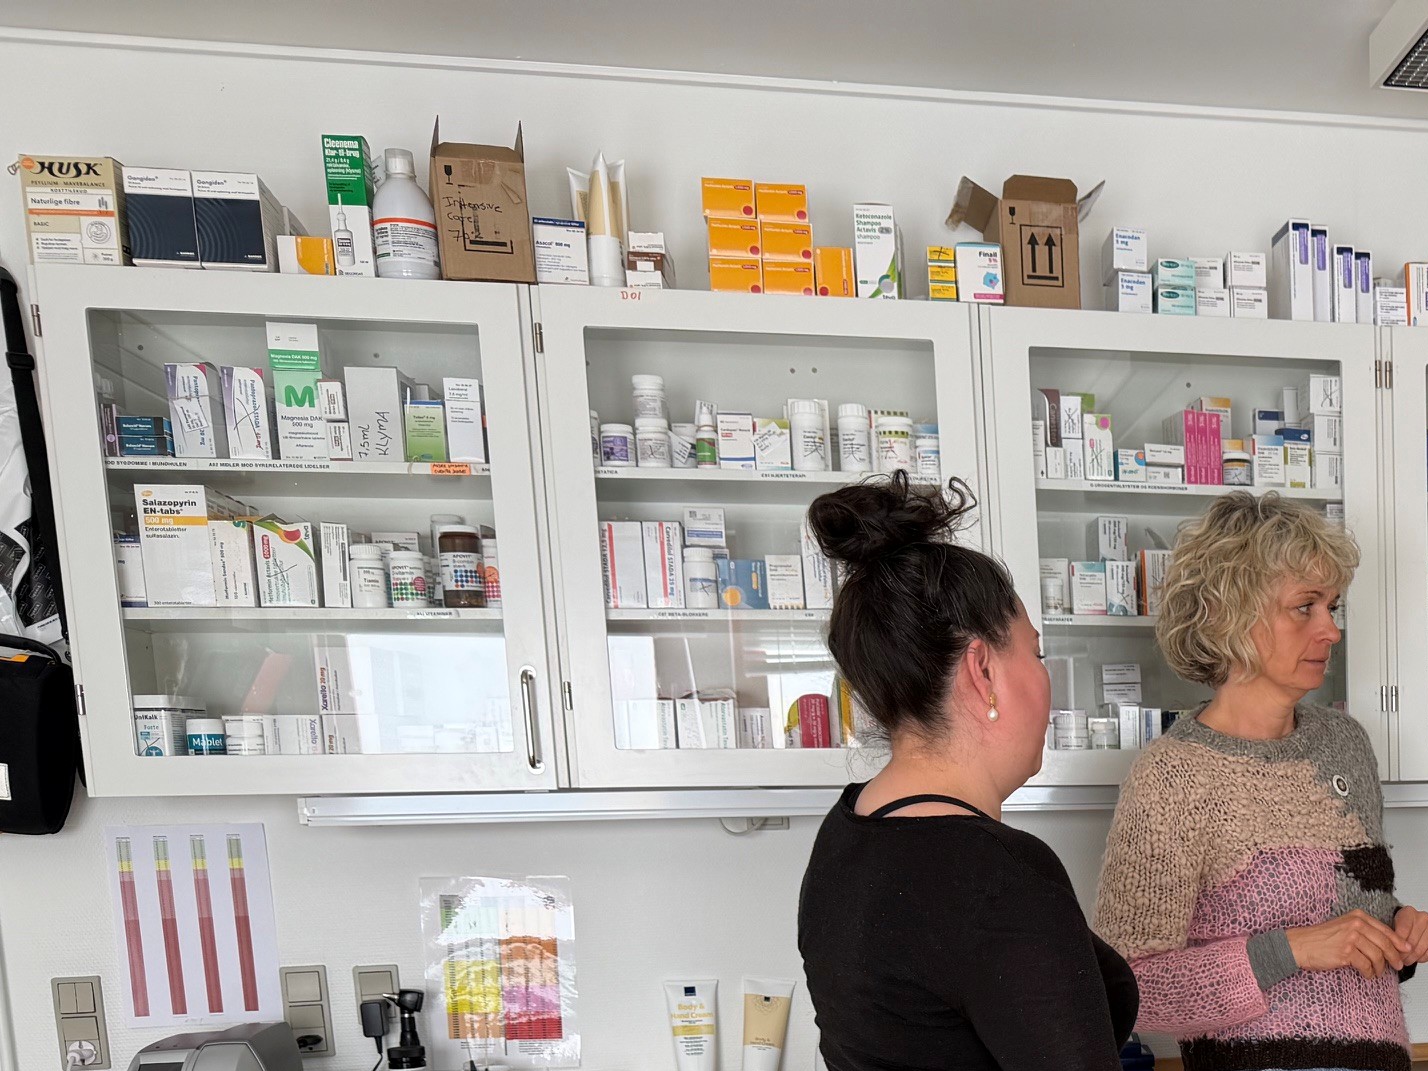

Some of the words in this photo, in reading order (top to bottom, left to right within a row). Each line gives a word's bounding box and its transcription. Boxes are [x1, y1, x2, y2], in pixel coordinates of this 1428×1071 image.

[30, 161, 102, 179] HUSK
[31, 198, 63, 207] Naturlige
[64, 198, 80, 206] fibre
[442, 196, 503, 213] Intensive
[447, 212, 473, 223] Care
[855, 213, 892, 221] Ketoconazole
[284, 384, 315, 408] M
[142, 498, 197, 507] Salazopyrin
[192, 737, 224, 746] Mablet
[677, 1003, 698, 1011] Body
[690, 1011, 713, 1019] Cream
